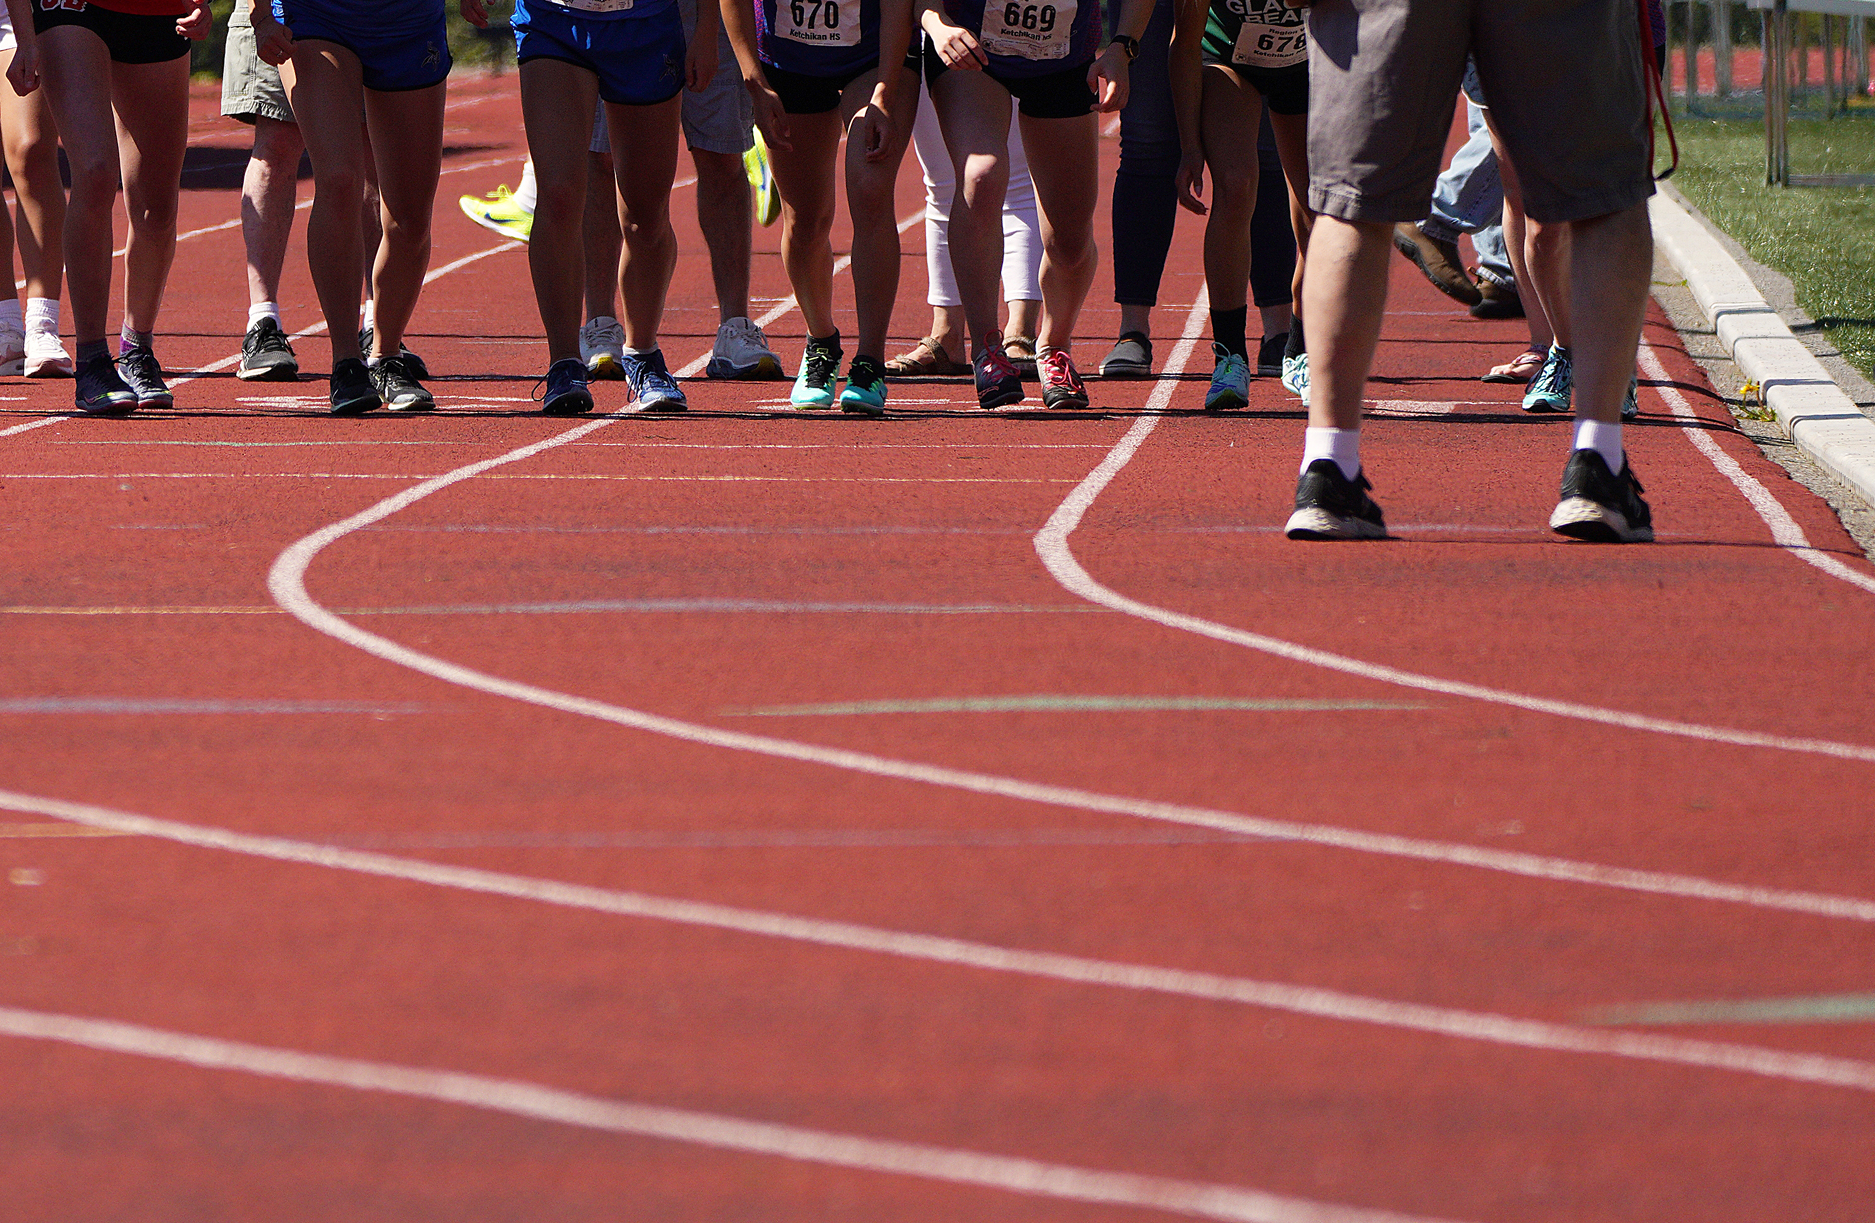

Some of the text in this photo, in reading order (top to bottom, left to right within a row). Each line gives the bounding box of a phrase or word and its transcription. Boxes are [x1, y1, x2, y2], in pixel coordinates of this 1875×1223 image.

[1003, 2, 1057, 33] 669
[789, 29, 841, 41] Ketchikan HS
[1257, 33, 1306, 52] 678
